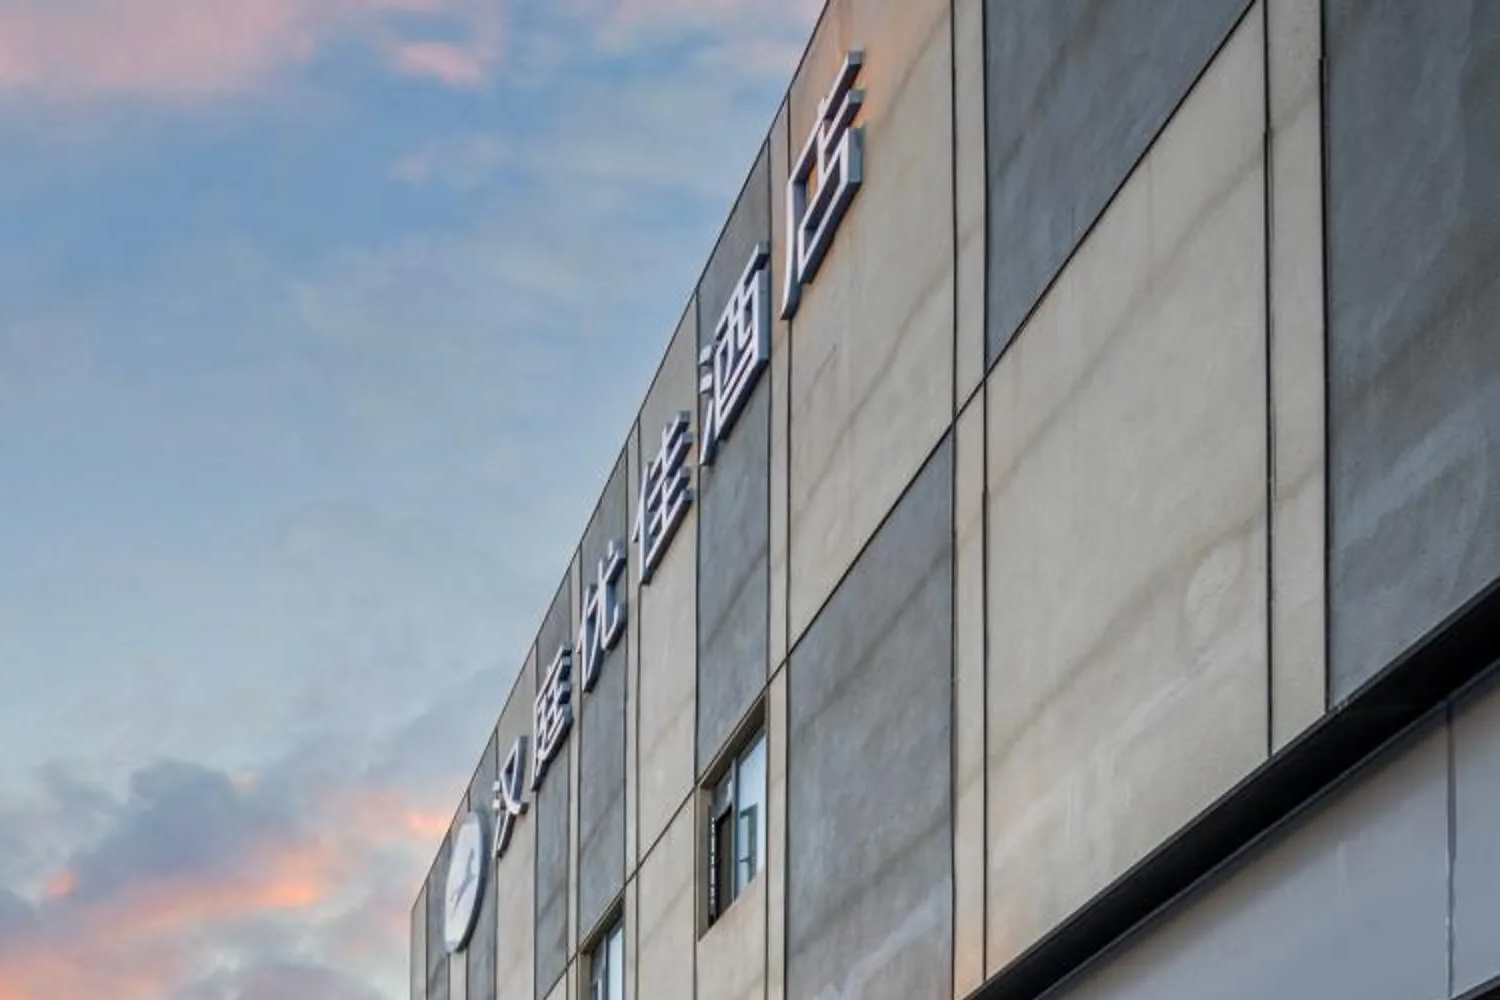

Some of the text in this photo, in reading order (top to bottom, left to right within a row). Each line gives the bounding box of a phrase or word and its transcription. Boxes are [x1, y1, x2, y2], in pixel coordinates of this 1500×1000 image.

[493, 50, 864, 860] 汉庭优佳酒店
